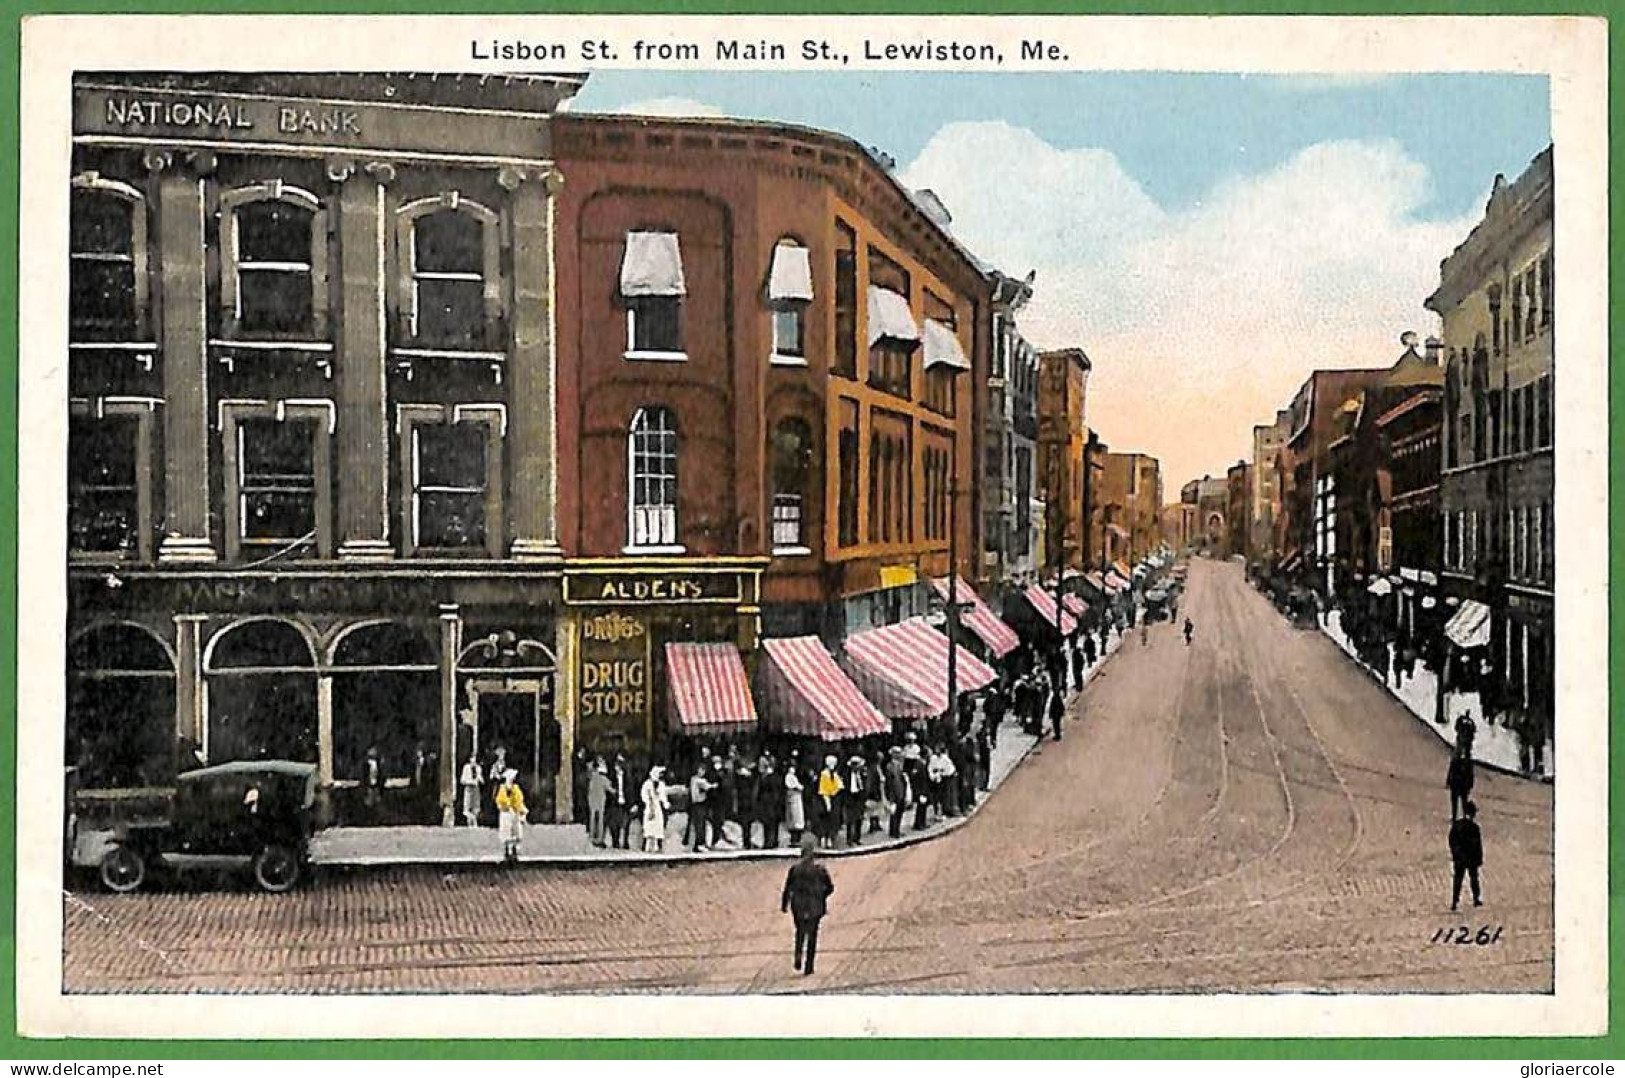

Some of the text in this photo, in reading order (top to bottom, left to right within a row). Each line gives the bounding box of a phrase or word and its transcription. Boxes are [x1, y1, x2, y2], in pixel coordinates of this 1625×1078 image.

[472, 39, 1069, 65] Lisbon St. from Main St., Lewiston, Me.
[106, 99, 362, 135] NATIONAL BANK
[582, 661, 643, 689] DRUG
[581, 691, 645, 716] STORE
[1430, 925, 1503, 945] 11261
